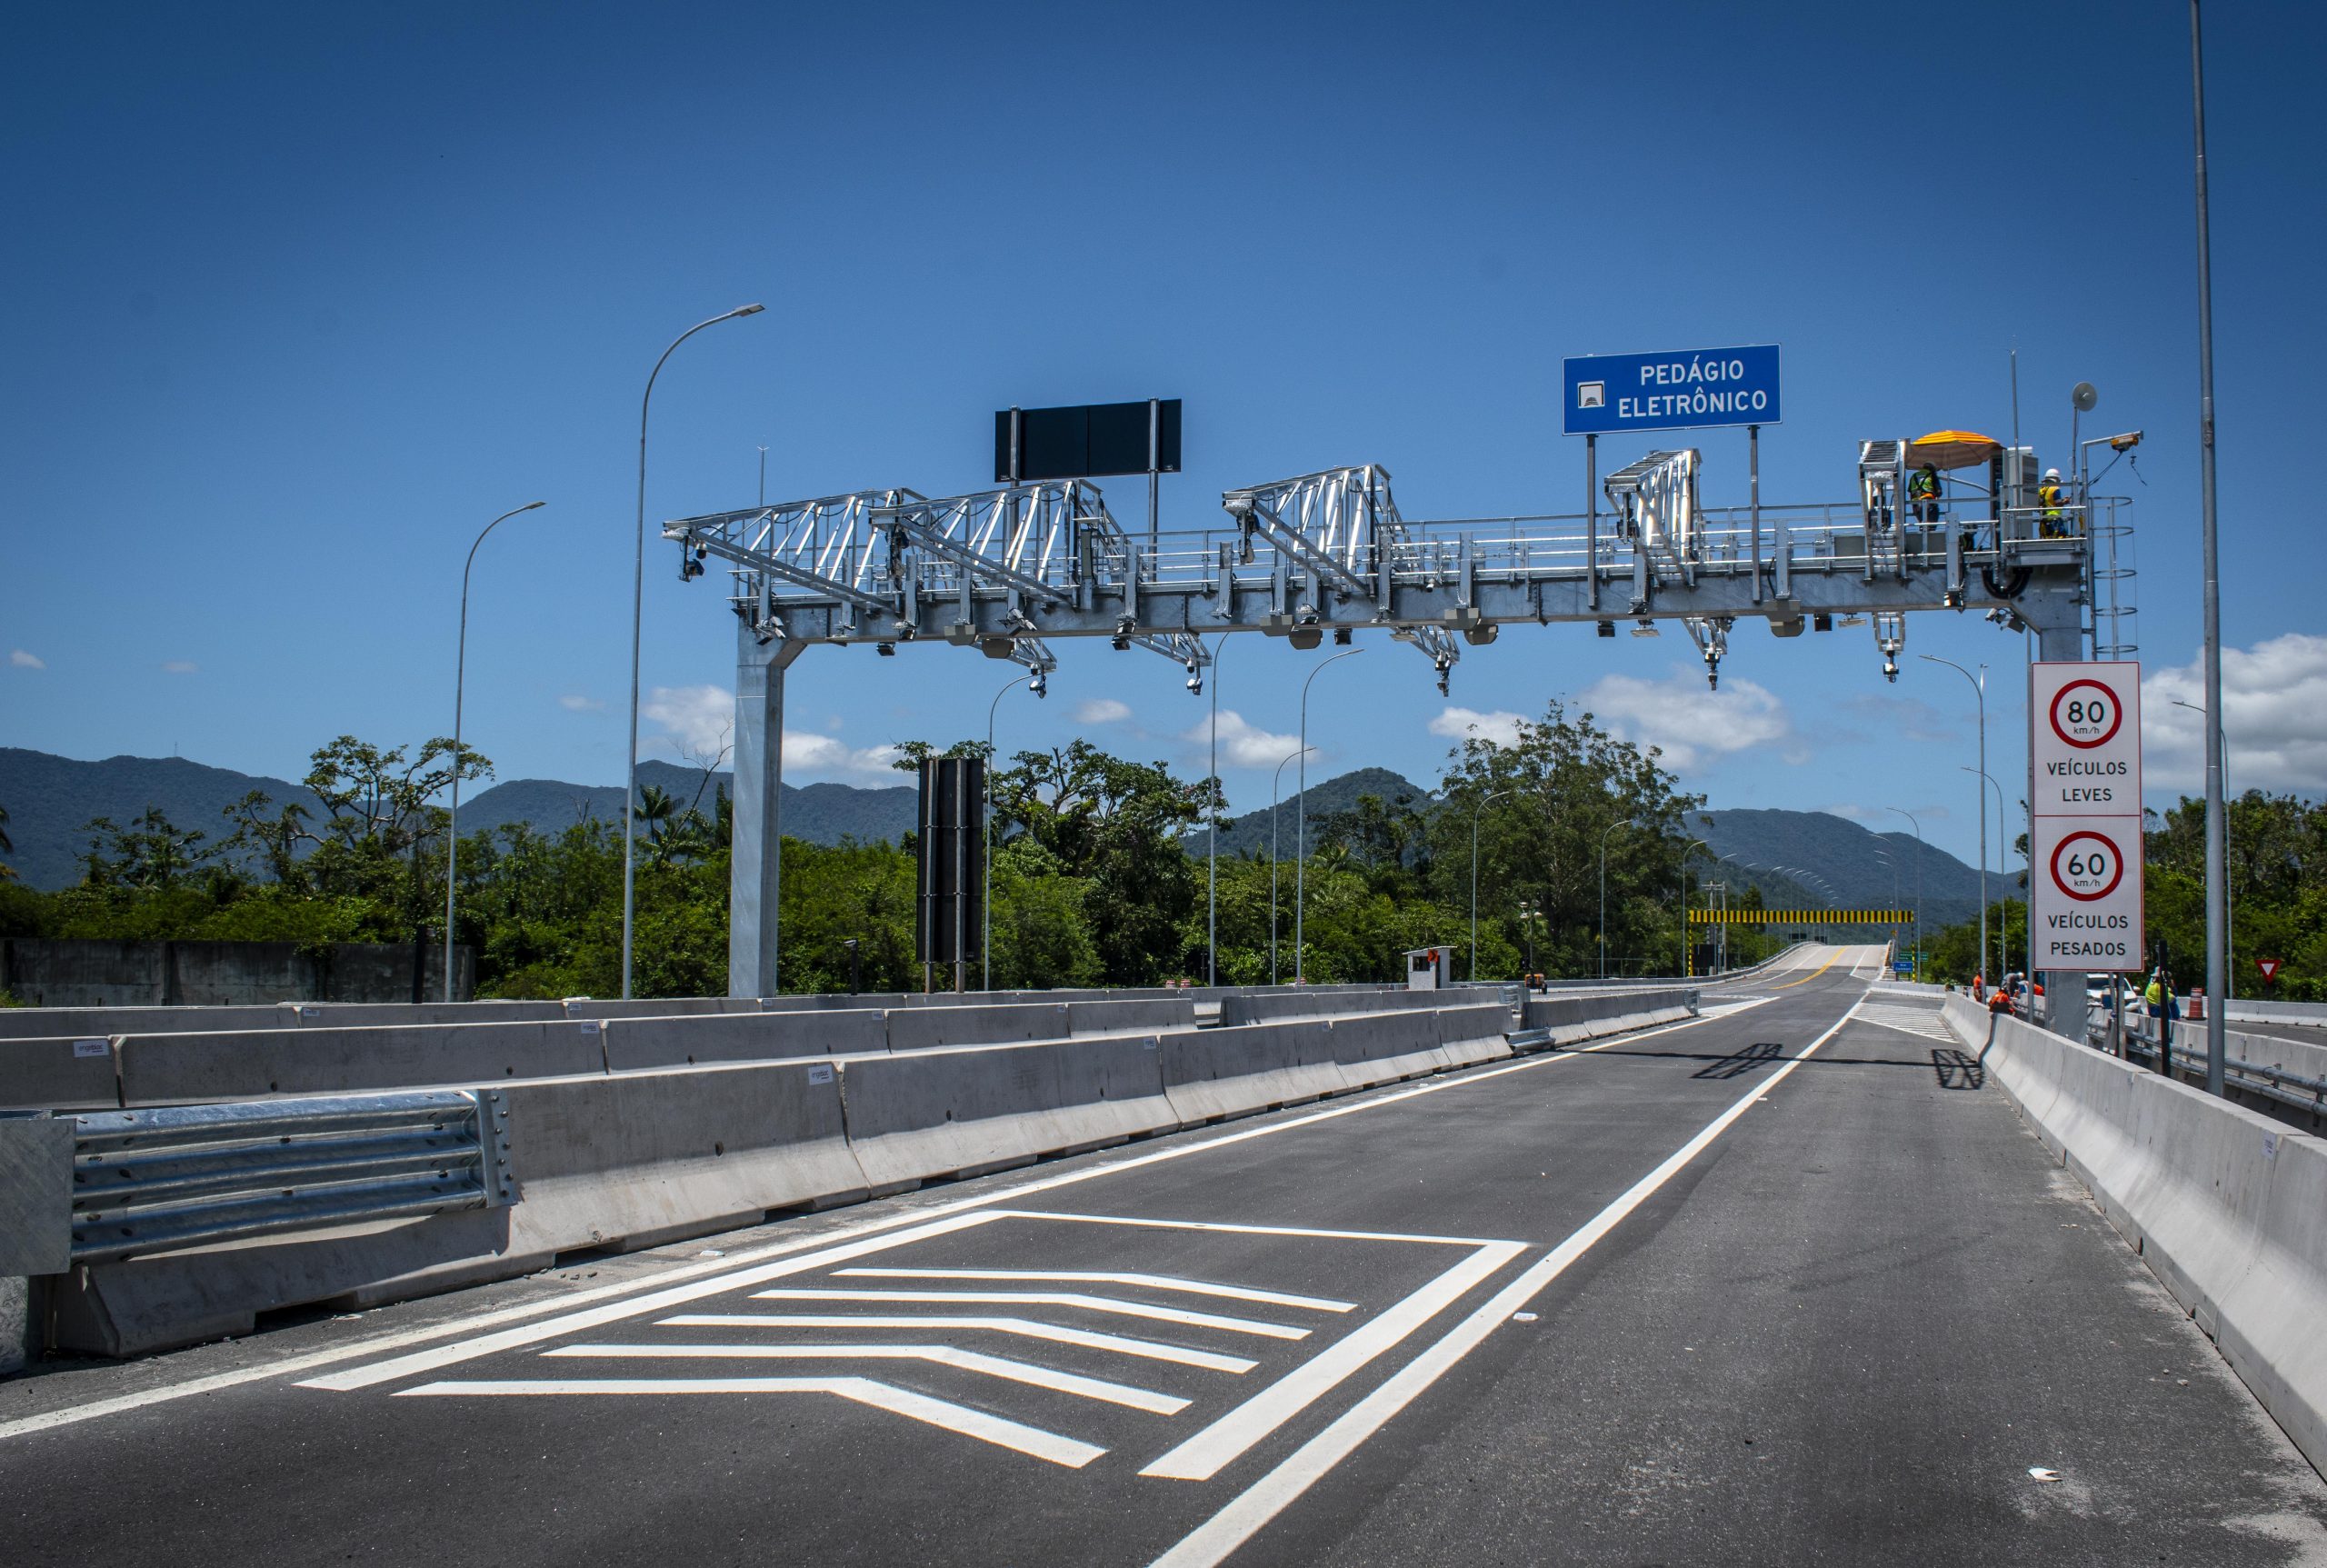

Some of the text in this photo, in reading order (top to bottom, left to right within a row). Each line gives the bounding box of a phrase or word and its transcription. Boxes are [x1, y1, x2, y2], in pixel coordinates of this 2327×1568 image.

[1641, 355, 1743, 385] PEDÁGIO
[1619, 386, 1767, 418] ELETRÔNICO
[2067, 701, 2105, 724] 80
[2073, 726, 2100, 734] km/h
[2047, 758, 2127, 775] VEÍCULOS
[2062, 788, 2112, 802] LEVES
[2068, 853, 2105, 876] 60
[2074, 879, 2101, 887] km/h
[2048, 911, 2129, 928] VEÍCULOS
[2051, 942, 2126, 955] PESADOS
